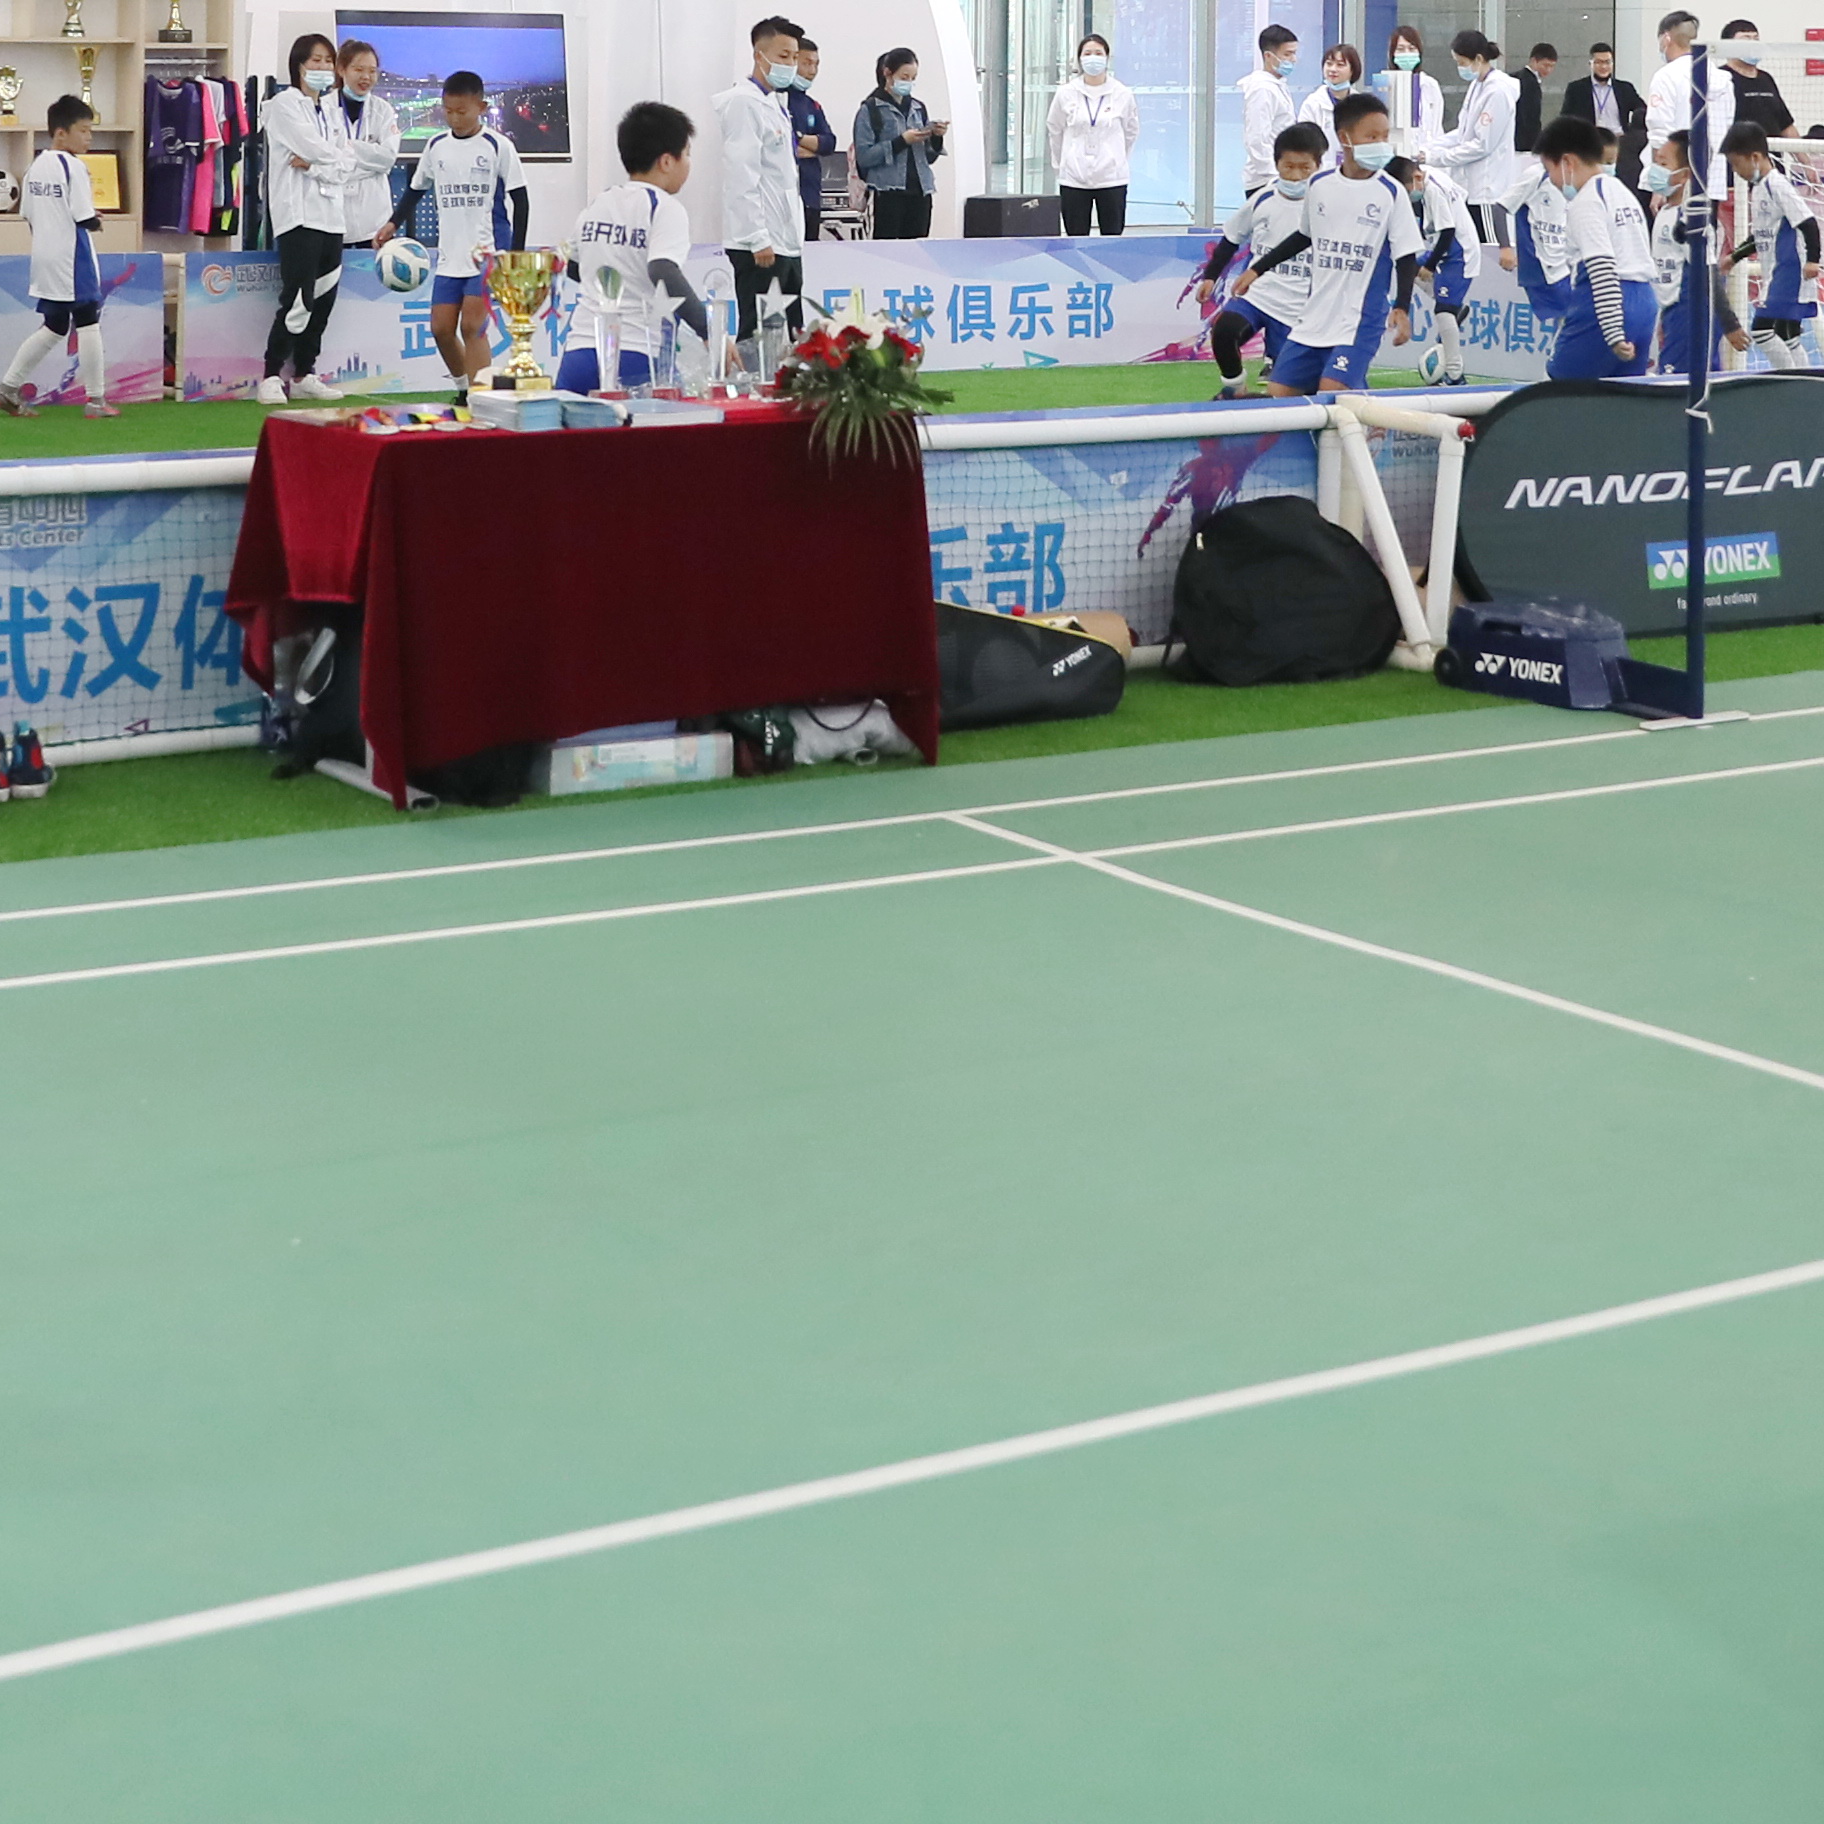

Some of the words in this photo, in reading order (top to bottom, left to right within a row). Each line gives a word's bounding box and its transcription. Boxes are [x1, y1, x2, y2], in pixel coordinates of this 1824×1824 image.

[581, 221, 648, 250] 经开外校
[236, 264, 281, 282] 武汉
[19, 526, 85, 547] Center
[1723, 591, 1758, 606] ordinary
[1064, 644, 1094, 668] YONEX
[1508, 655, 1563, 686] YONEX
